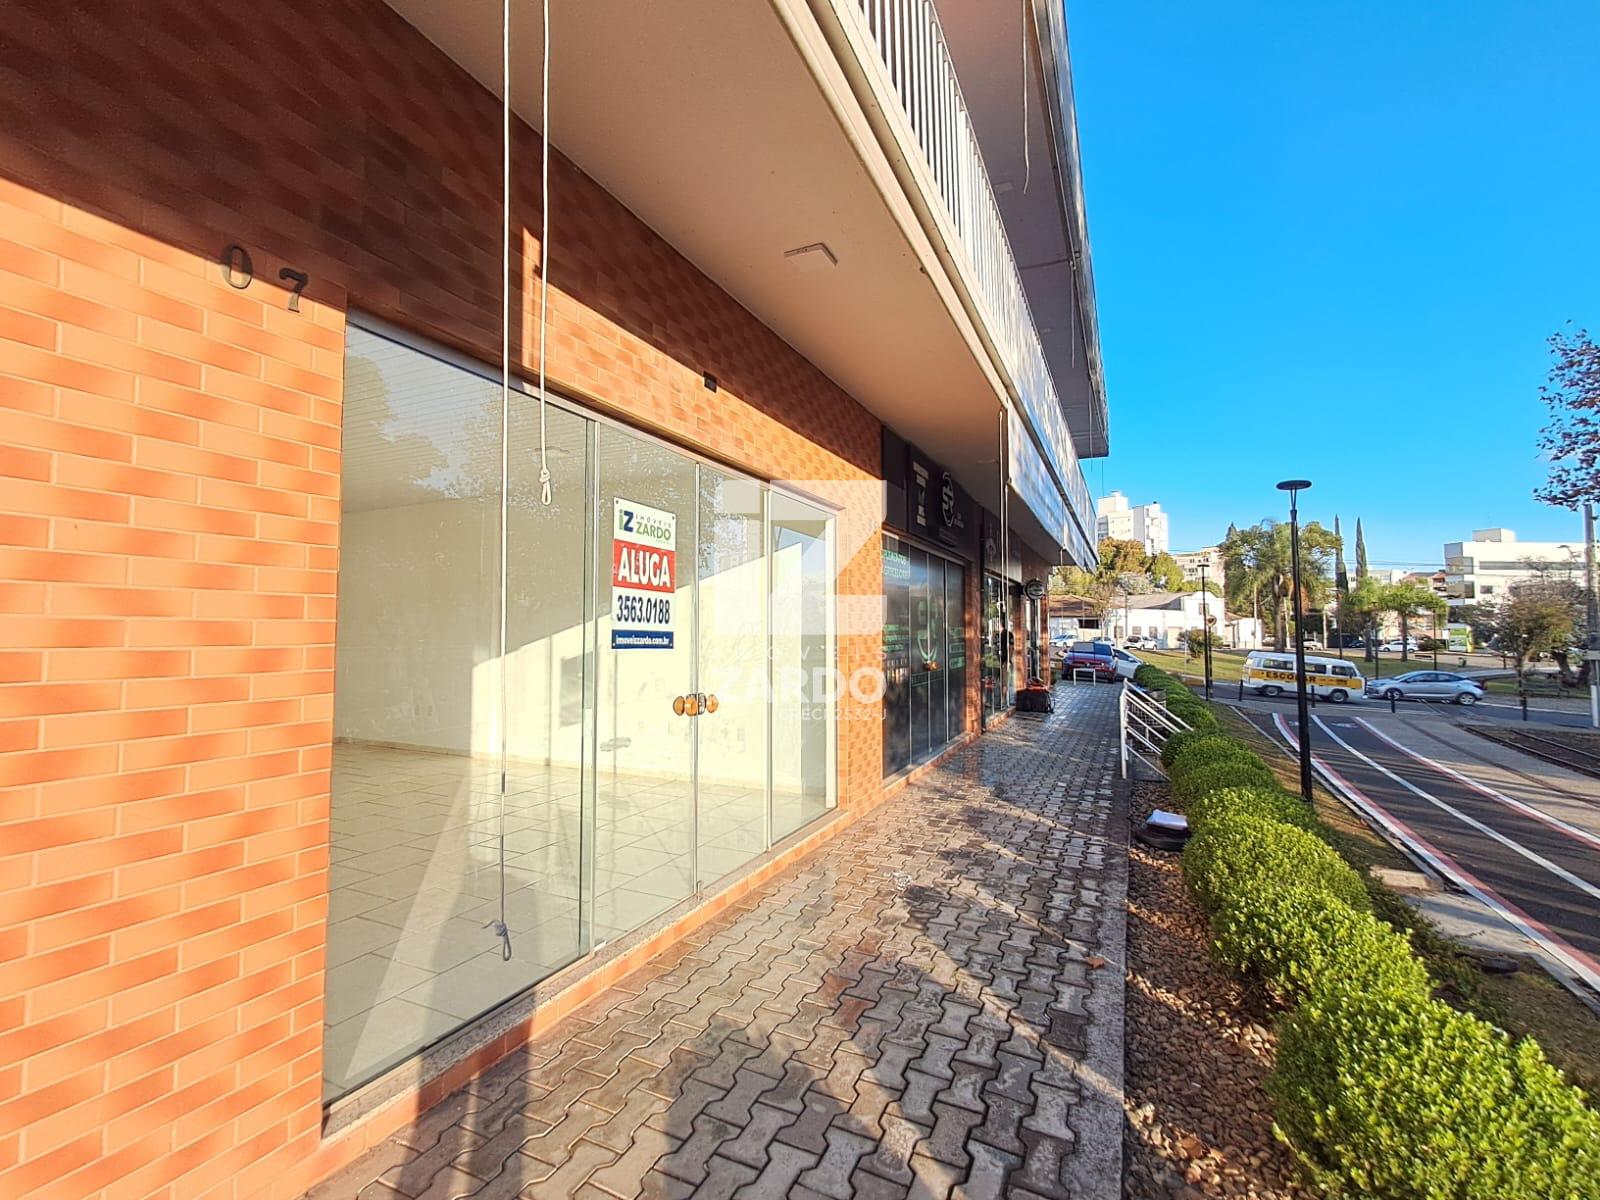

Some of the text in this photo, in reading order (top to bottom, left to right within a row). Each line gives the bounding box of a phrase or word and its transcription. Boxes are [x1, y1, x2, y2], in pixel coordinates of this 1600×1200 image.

[636, 521, 672, 541] ZARDO
[617, 547, 671, 588] ALUGA
[616, 595, 670, 624] 3563.0188
[1266, 671, 1316, 683] ESCOR
